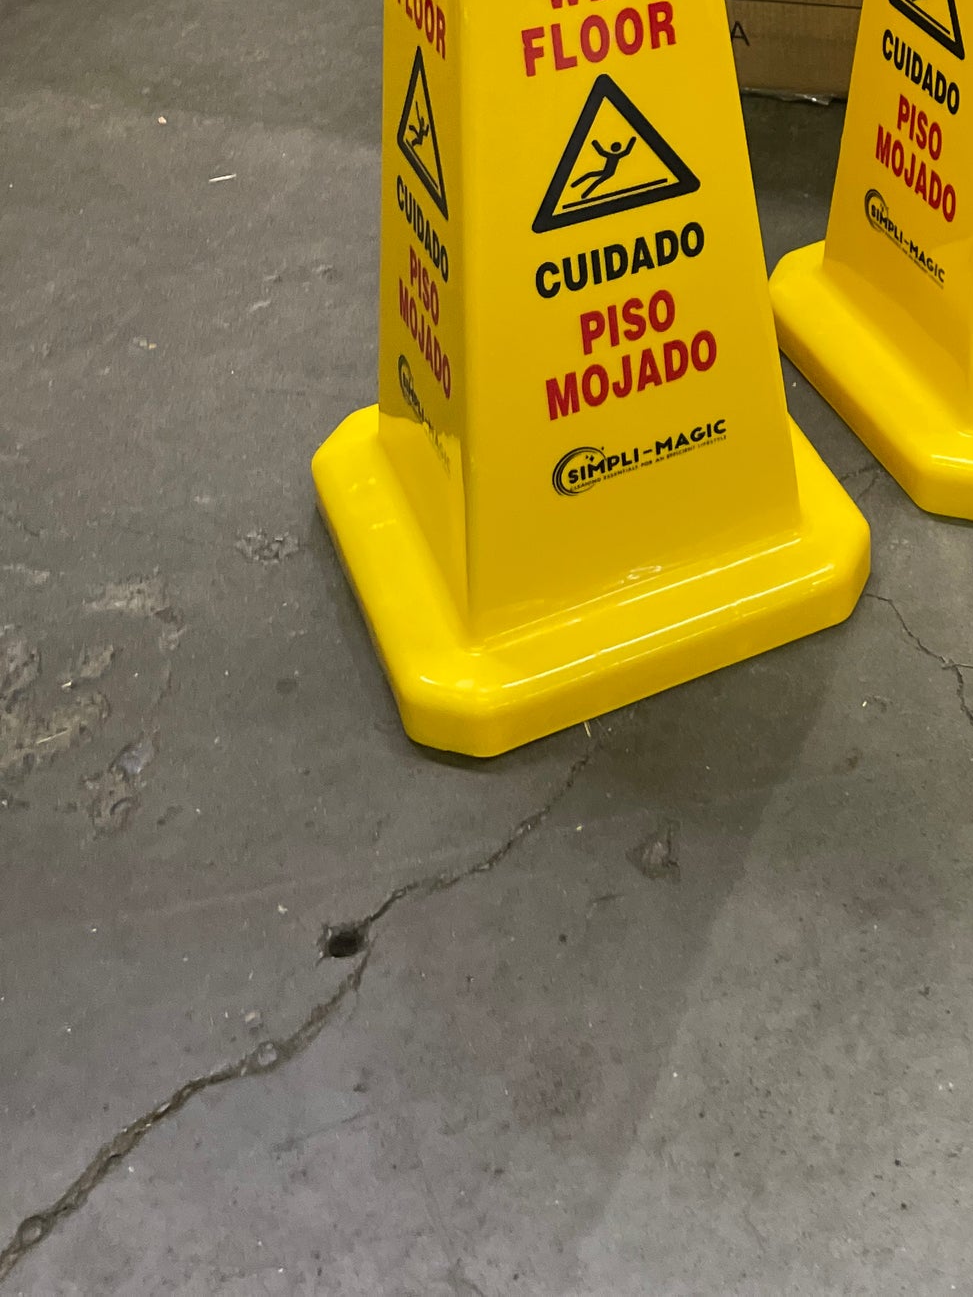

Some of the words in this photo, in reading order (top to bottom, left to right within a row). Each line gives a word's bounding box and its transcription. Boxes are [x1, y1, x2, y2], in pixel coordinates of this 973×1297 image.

[521, 0, 676, 77] FLOOR
[882, 29, 960, 115] CUIDADO
[897, 94, 942, 161] PISO
[876, 124, 956, 223] MOJADO
[397, 175, 448, 283] CUIDADO
[535, 222, 705, 298] CUIDADO
[871, 204, 945, 283] SIMPLI-MAGIC
[409, 245, 439, 326] PISO
[580, 290, 676, 355] PISO
[399, 277, 451, 400] MOJADO
[545, 330, 717, 420] MOJADO
[568, 419, 726, 484] SIMPLI-MAGIC
